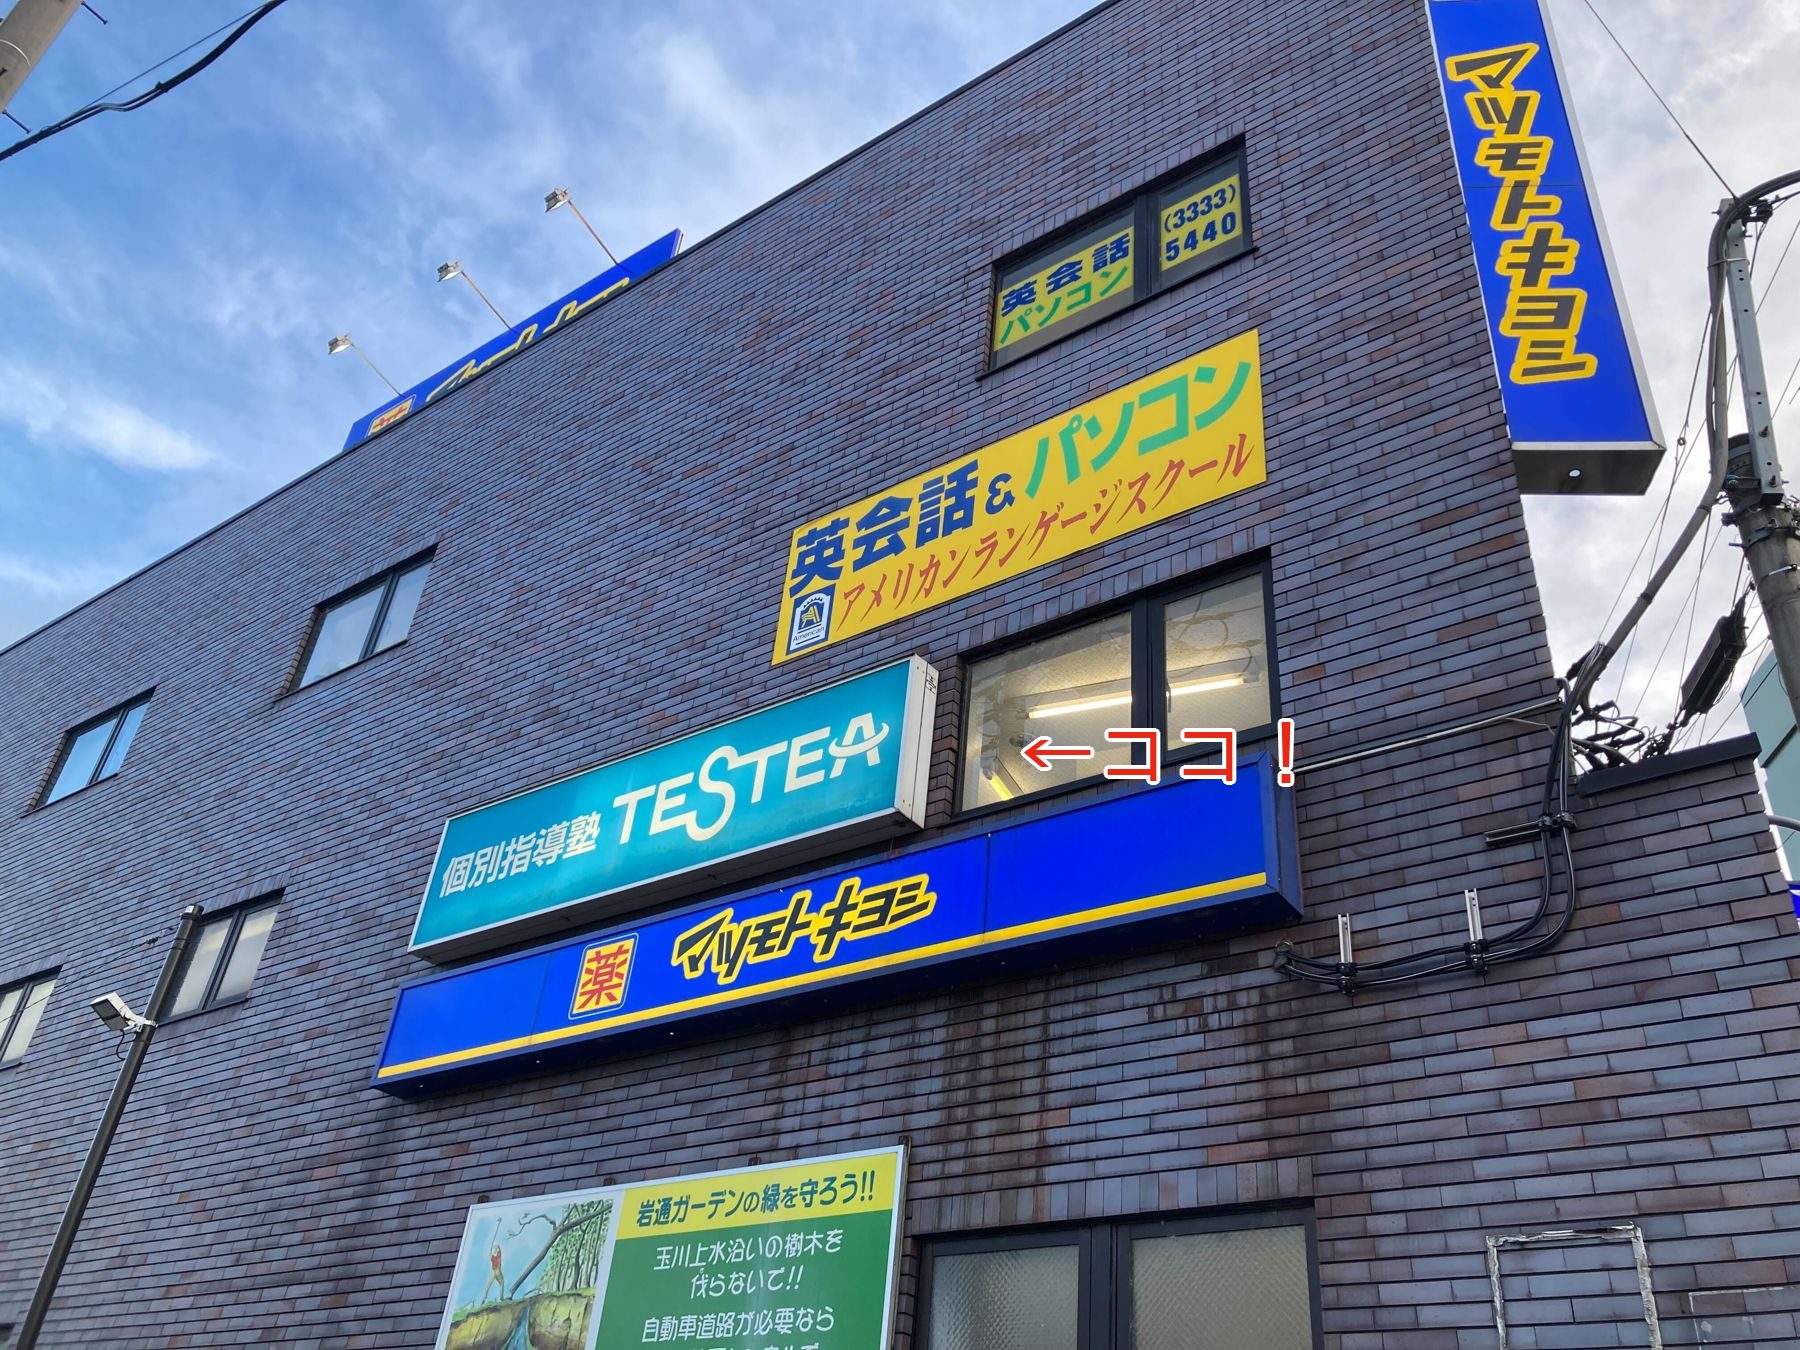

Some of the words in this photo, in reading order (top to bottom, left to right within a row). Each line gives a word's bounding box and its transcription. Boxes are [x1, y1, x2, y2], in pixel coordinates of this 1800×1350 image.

[1164, 184, 1236, 232] (3333)
[1165, 211, 1236, 262] 5440
[1445, 42, 1598, 384] マツモトキヨシ
[1000, 266, 1129, 344] パソコン
[1001, 233, 1131, 317] 英会話
[836, 433, 1255, 632] アメリカンランゲージスクール
[793, 626, 825, 642] American
[439, 811, 602, 898] 個別指導塾
[612, 712, 889, 842] TESTEA
[671, 873, 938, 984] マツモトキヨシ
[576, 943, 626, 1010] 薬
[636, 1170, 876, 1228] 岩通ガーデンの緑を守ろう!!
[653, 1228, 844, 1271] 玉川上水沿いの樹木を
[690, 1265, 804, 1300] 伐らないで!!
[641, 1306, 836, 1343] 自動車道路が必要なら
